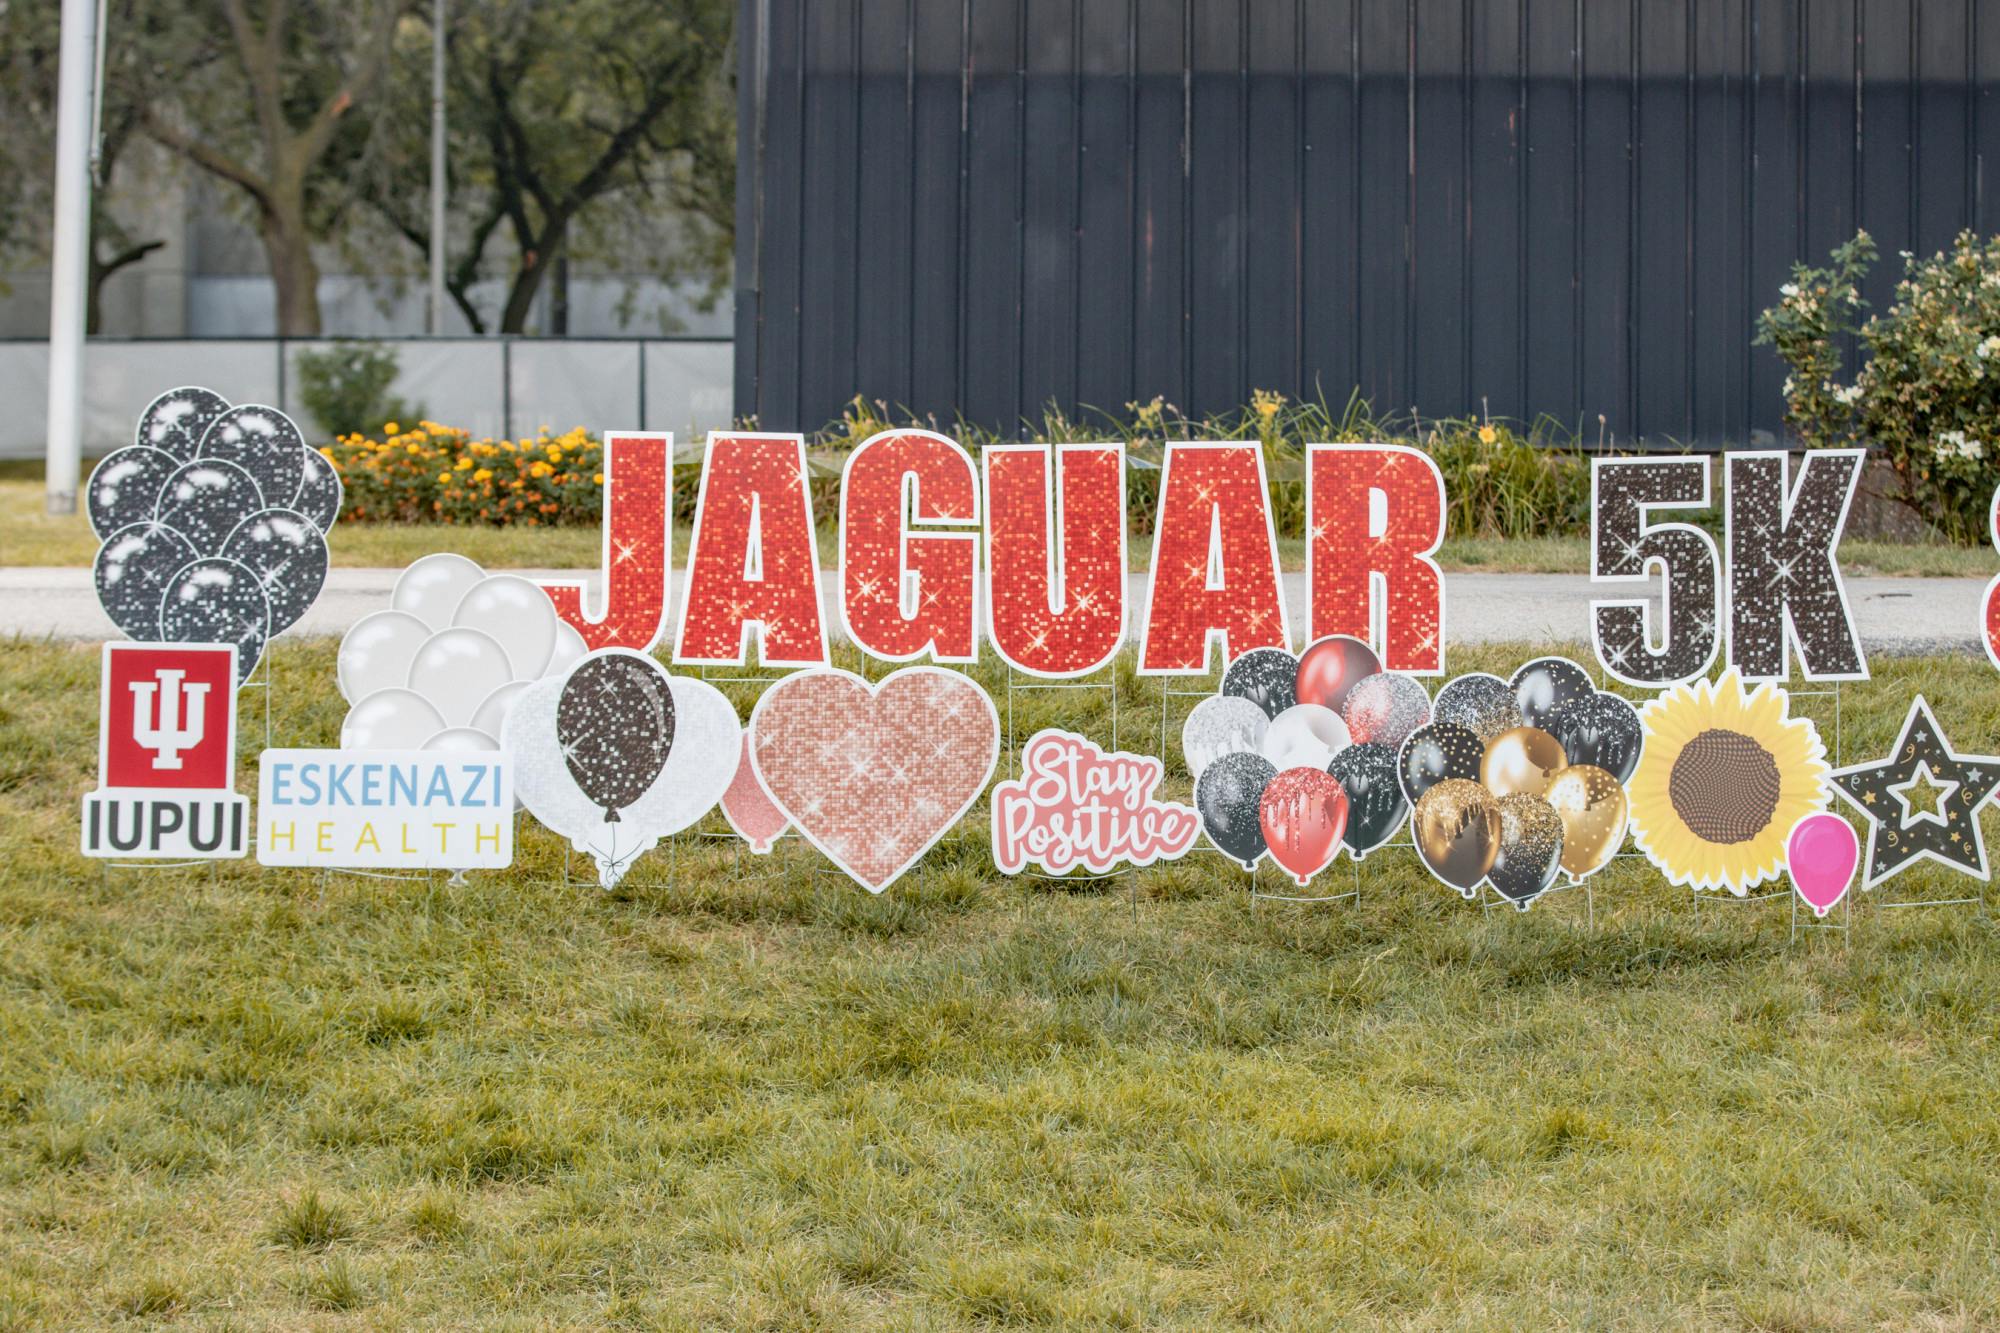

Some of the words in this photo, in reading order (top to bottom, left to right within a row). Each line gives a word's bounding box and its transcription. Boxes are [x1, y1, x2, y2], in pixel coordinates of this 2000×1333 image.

[541, 428, 1446, 678] JAGUAR
[1590, 449, 1869, 687] 5K
[272, 763, 501, 807] ESKENAZI
[1030, 742, 1154, 811] Stay
[89, 801, 242, 851] IUPUI
[270, 822, 500, 854] HEALTH
[1004, 796, 1191, 864] Positive
